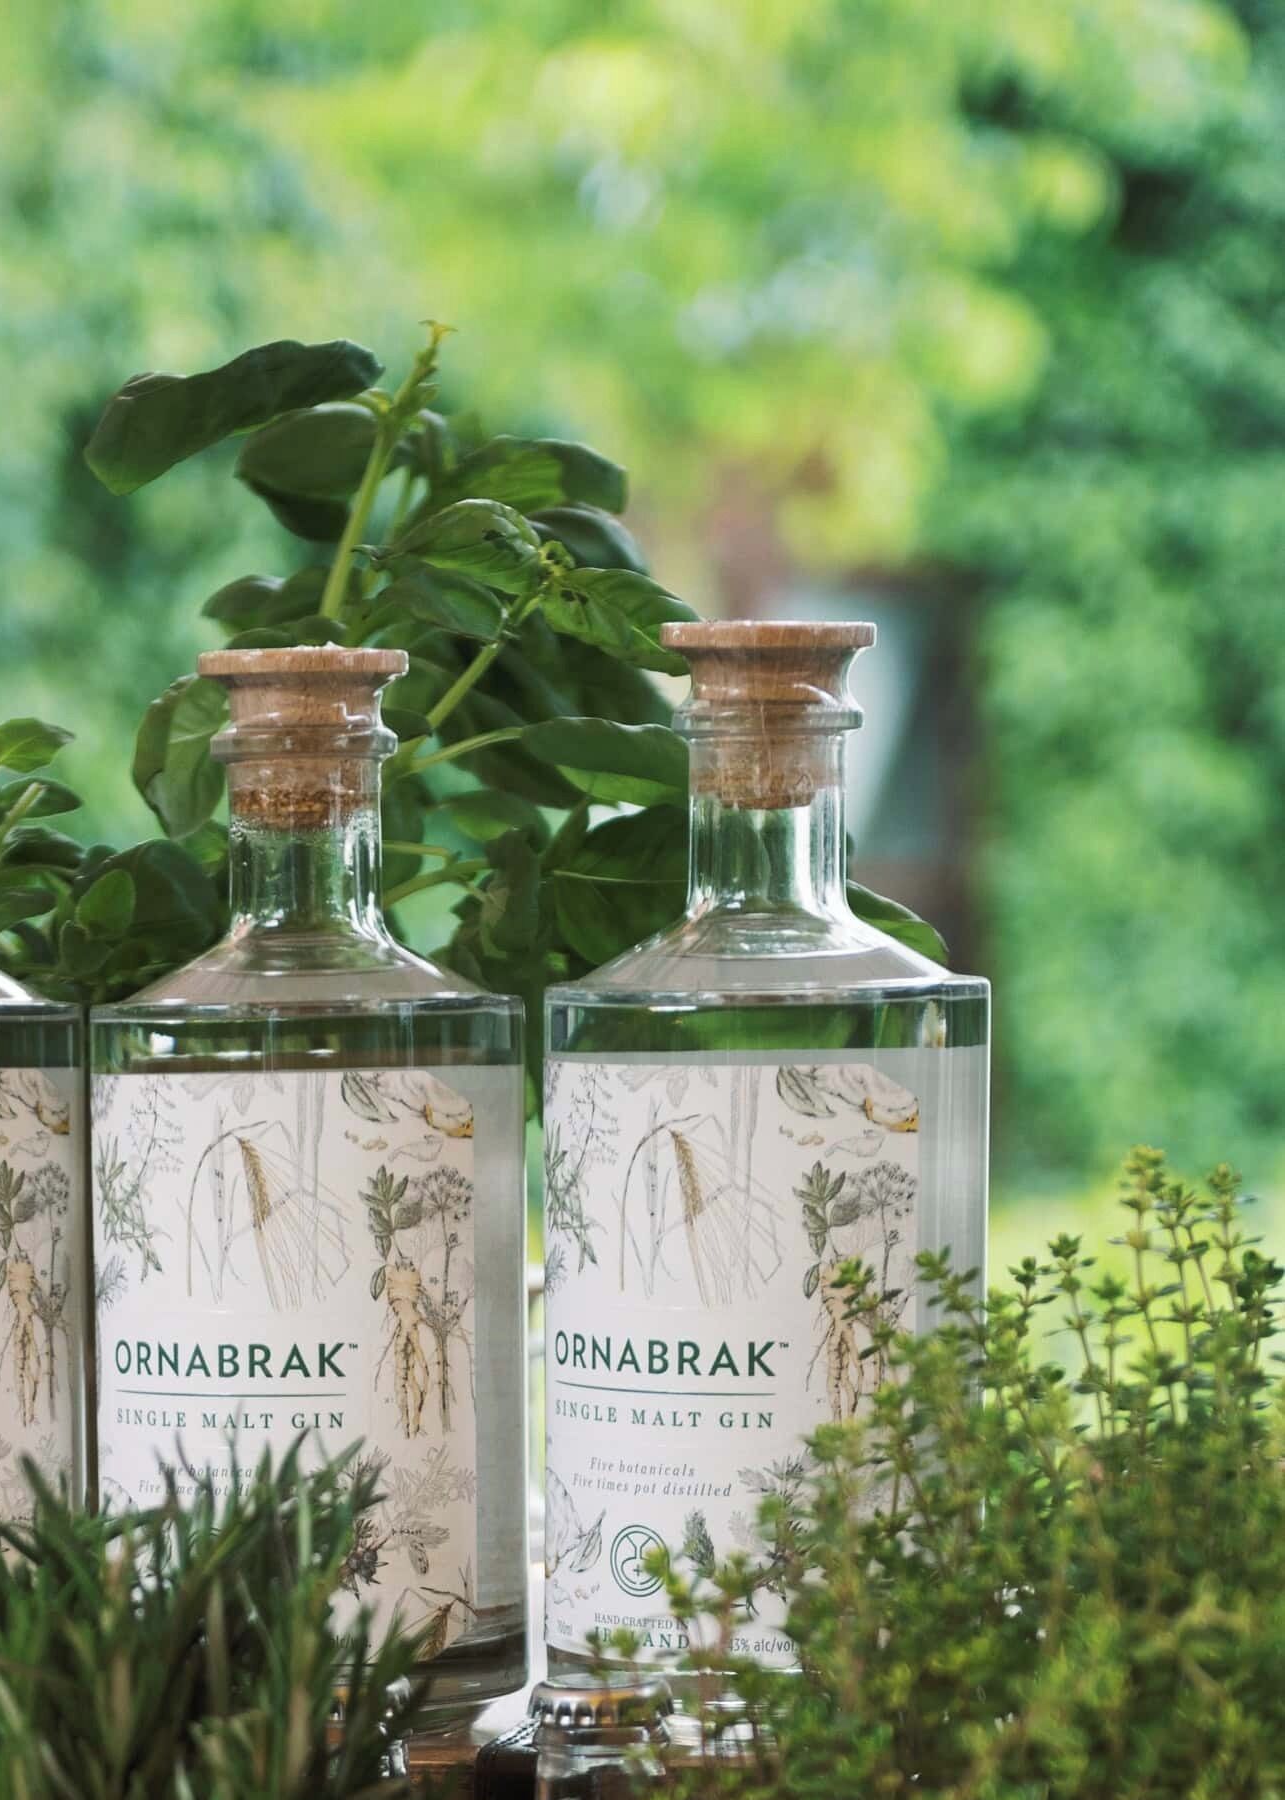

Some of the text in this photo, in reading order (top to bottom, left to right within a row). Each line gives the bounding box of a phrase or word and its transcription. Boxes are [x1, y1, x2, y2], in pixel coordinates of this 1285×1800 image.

[116, 1407, 345, 1430] SINGLE MALT GIN
[555, 1399, 774, 1429] SINGLE MALT GIN
[590, 1456, 696, 1478] Five botanicals
[572, 1473, 733, 1498] Five times pot distilled
[594, 1612, 620, 1626] HAND
[622, 1615, 673, 1631] CRAFTED
